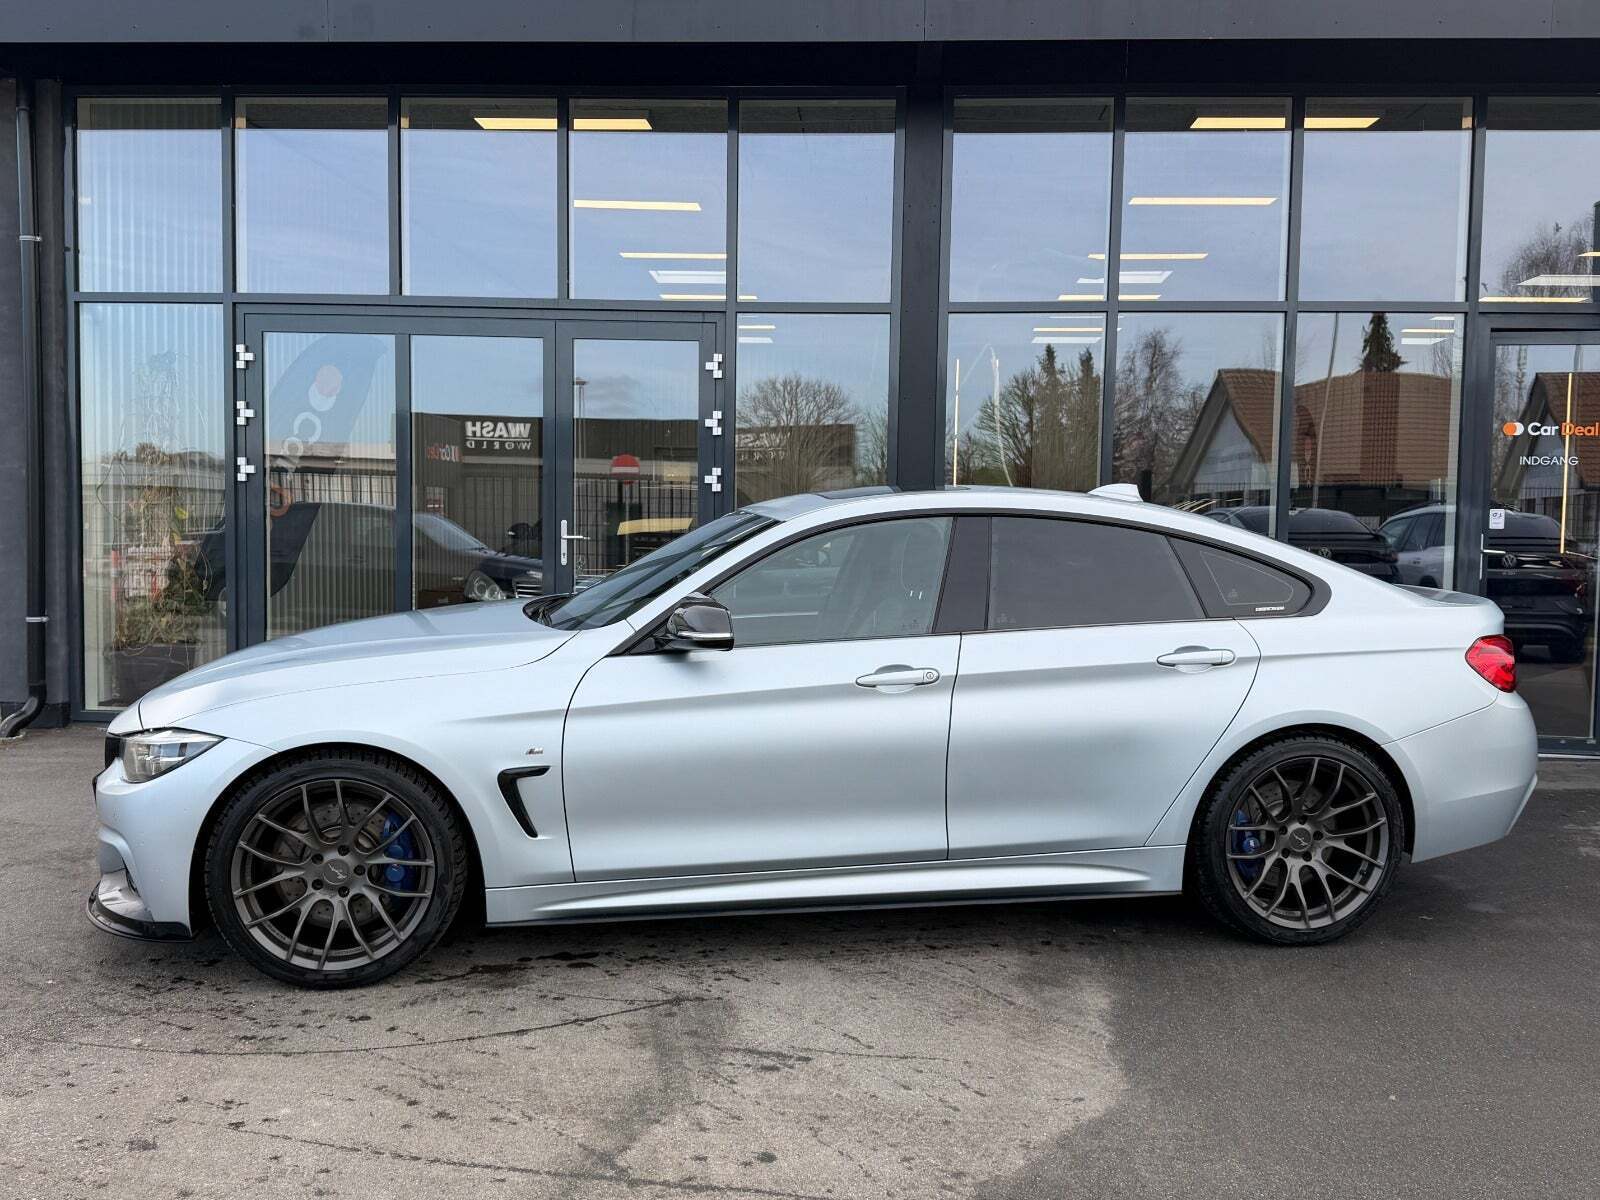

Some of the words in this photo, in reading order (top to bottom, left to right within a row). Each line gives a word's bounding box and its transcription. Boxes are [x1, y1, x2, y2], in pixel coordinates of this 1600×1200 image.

[1527, 421, 1559, 436] Car
[1561, 422, 1600, 436] Deal
[1519, 455, 1579, 466] INDGANG
